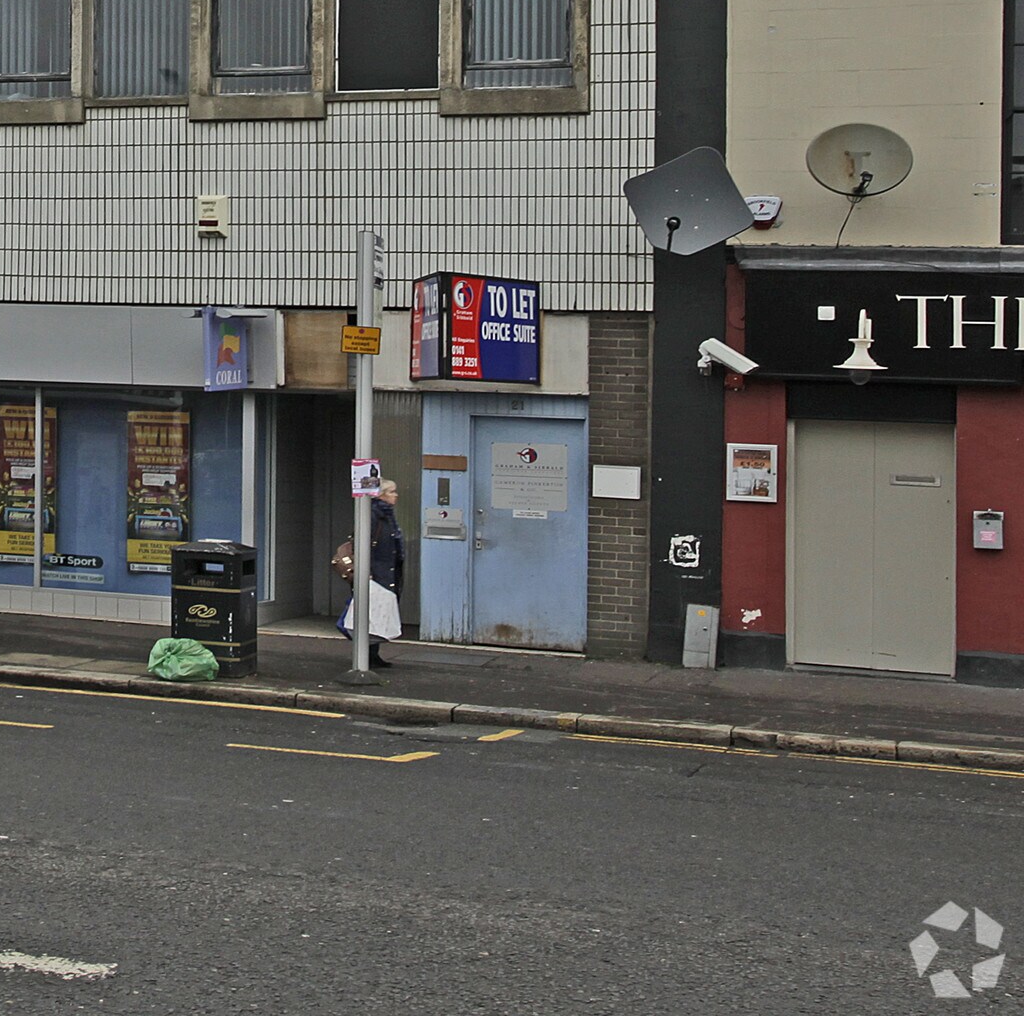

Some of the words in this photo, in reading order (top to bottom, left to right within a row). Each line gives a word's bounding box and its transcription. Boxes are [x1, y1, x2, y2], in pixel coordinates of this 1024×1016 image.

[488, 285, 508, 318] TO
[512, 287, 536, 320] LET
[481, 321, 511, 342] OFFICE
[513, 324, 536, 344] SUITE
[452, 345, 465, 355] 0141
[452, 357, 463, 367] 889
[464, 358, 478, 368] 3251
[216, 369, 242, 386] CORAL
[511, 400, 525, 411] 21
[134, 425, 184, 447] WIN
[48, 554, 67, 564] BT
[67, 555, 97, 567] Sport
